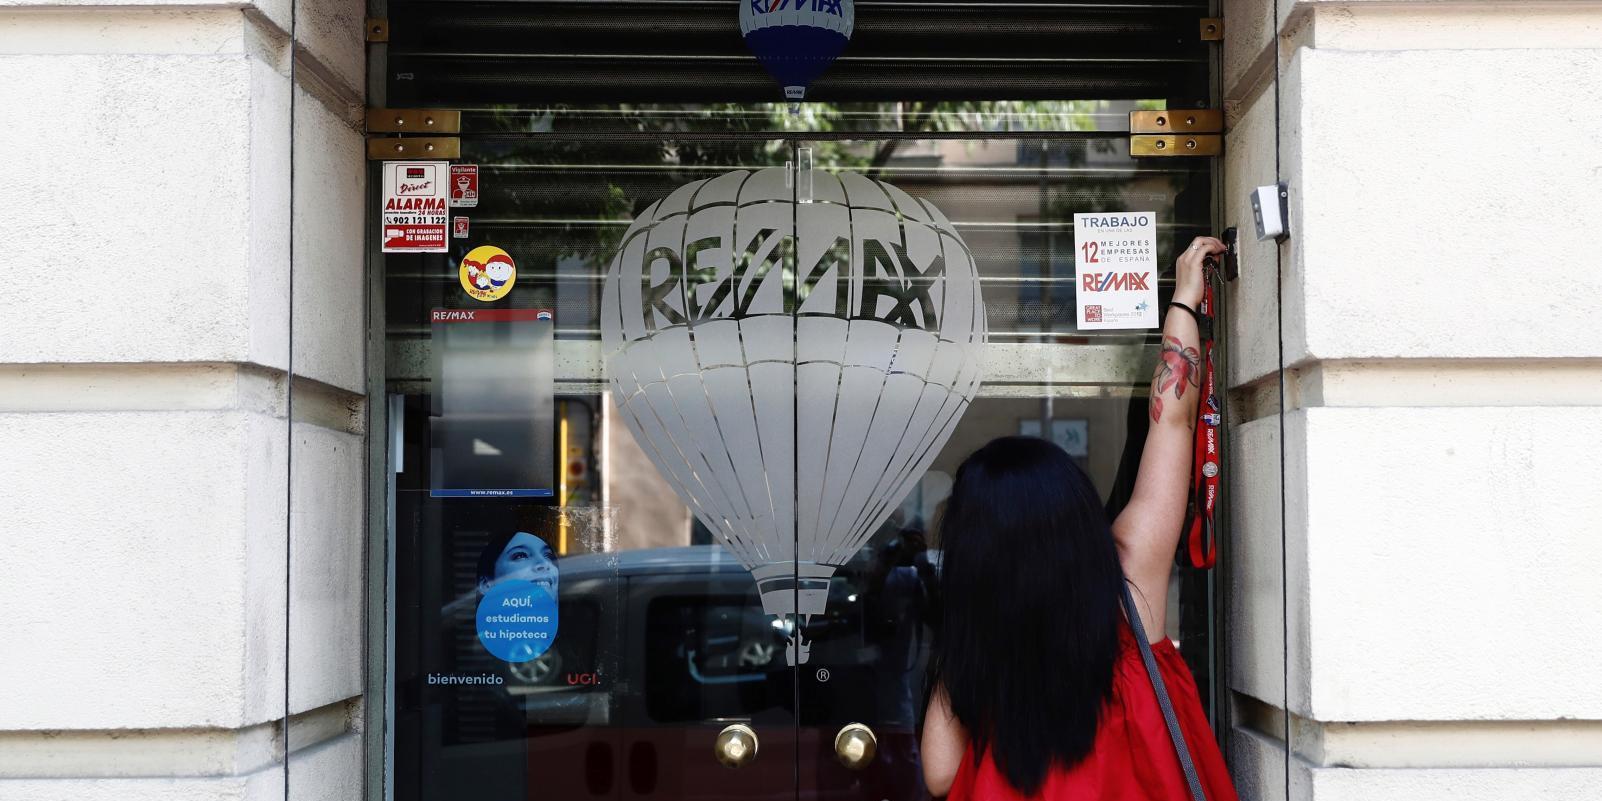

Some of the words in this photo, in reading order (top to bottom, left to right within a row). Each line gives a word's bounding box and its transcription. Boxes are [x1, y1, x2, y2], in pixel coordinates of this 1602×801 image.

[400, 181, 431, 194] Direct
[386, 198, 446, 210] ALARMA
[1081, 216, 1149, 228] TRABAJO
[1081, 241, 1099, 263] 12
[1082, 271, 1150, 292] RE/MAX
[433, 311, 475, 320] RE/MAX
[502, 596, 533, 608] AQUÍ,
[485, 613, 549, 623] estudiamos
[484, 630, 497, 639] tu
[499, 629, 547, 641] hipoteca
[427, 673, 504, 685] bienvenido
